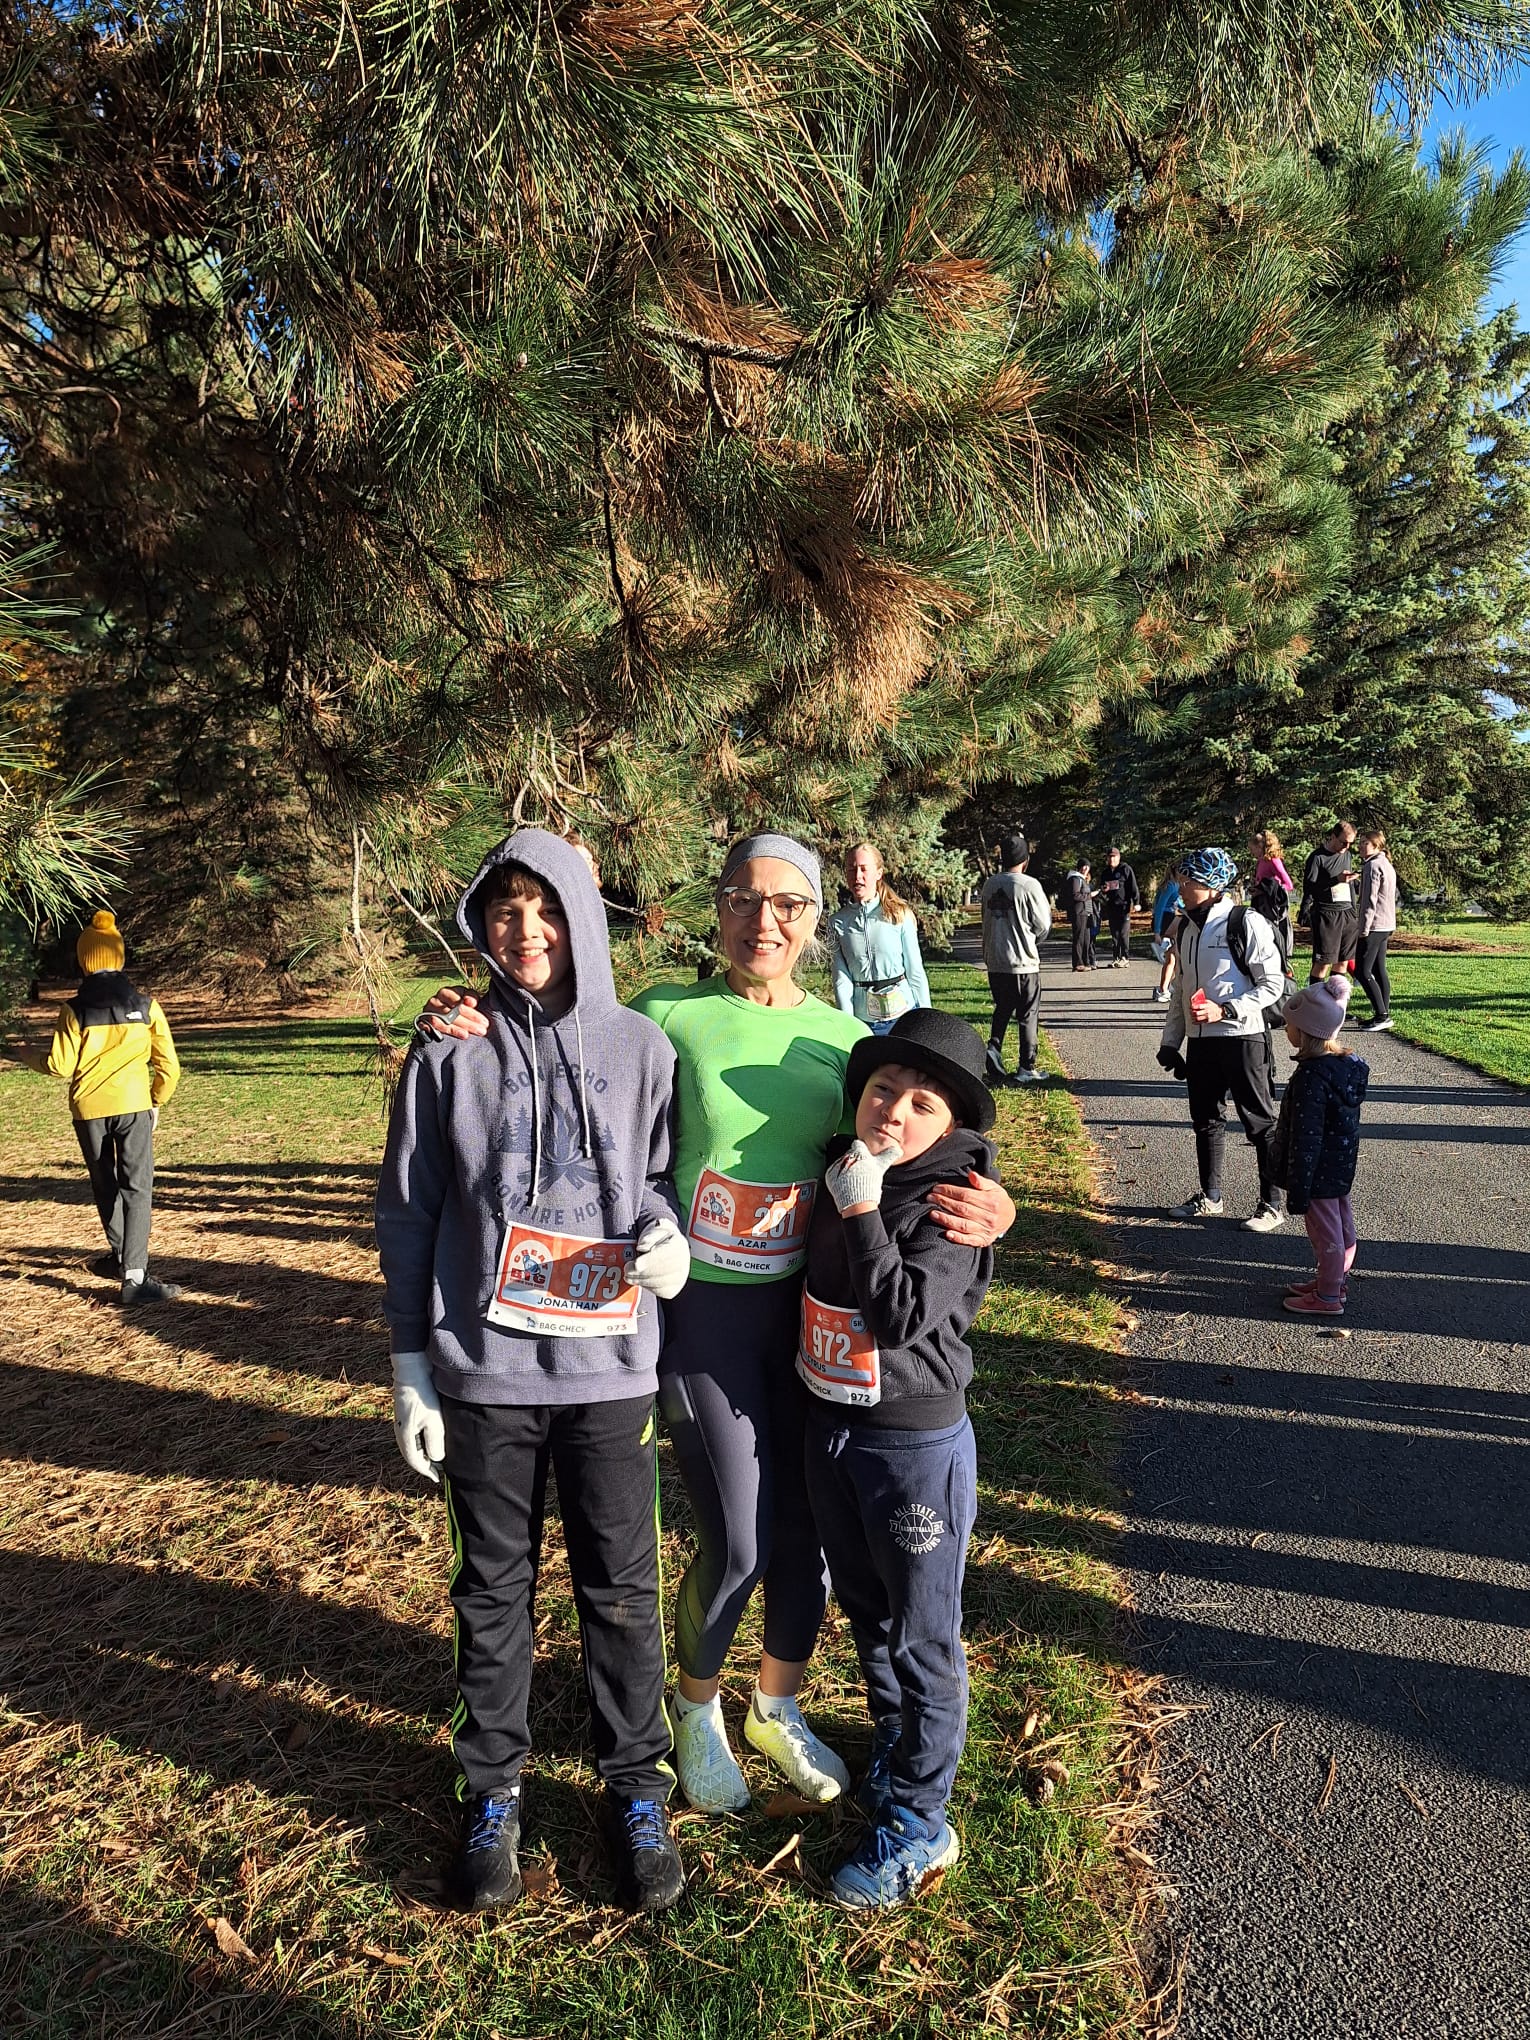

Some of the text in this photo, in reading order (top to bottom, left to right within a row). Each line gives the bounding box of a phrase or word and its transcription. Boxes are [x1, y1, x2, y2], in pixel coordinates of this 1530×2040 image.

[554, 1062, 608, 1094] ECHO
[703, 1191, 732, 1213] GREAT
[700, 1207, 730, 1226] BIG
[737, 1239, 768, 1249] AZAR
[514, 1249, 549, 1270] GREAT
[725, 1258, 771, 1271] BAG CHECK
[510, 1267, 546, 1285] BIG
[568, 1263, 622, 1300] 973
[537, 1296, 600, 1311] JONATHAN
[539, 1322, 586, 1333] BAG CHECK
[606, 1324, 628, 1333] 973
[812, 1324, 853, 1367] 972
[850, 1392, 871, 1403] 972
[894, 1536, 942, 1555] CHAMPIONS
